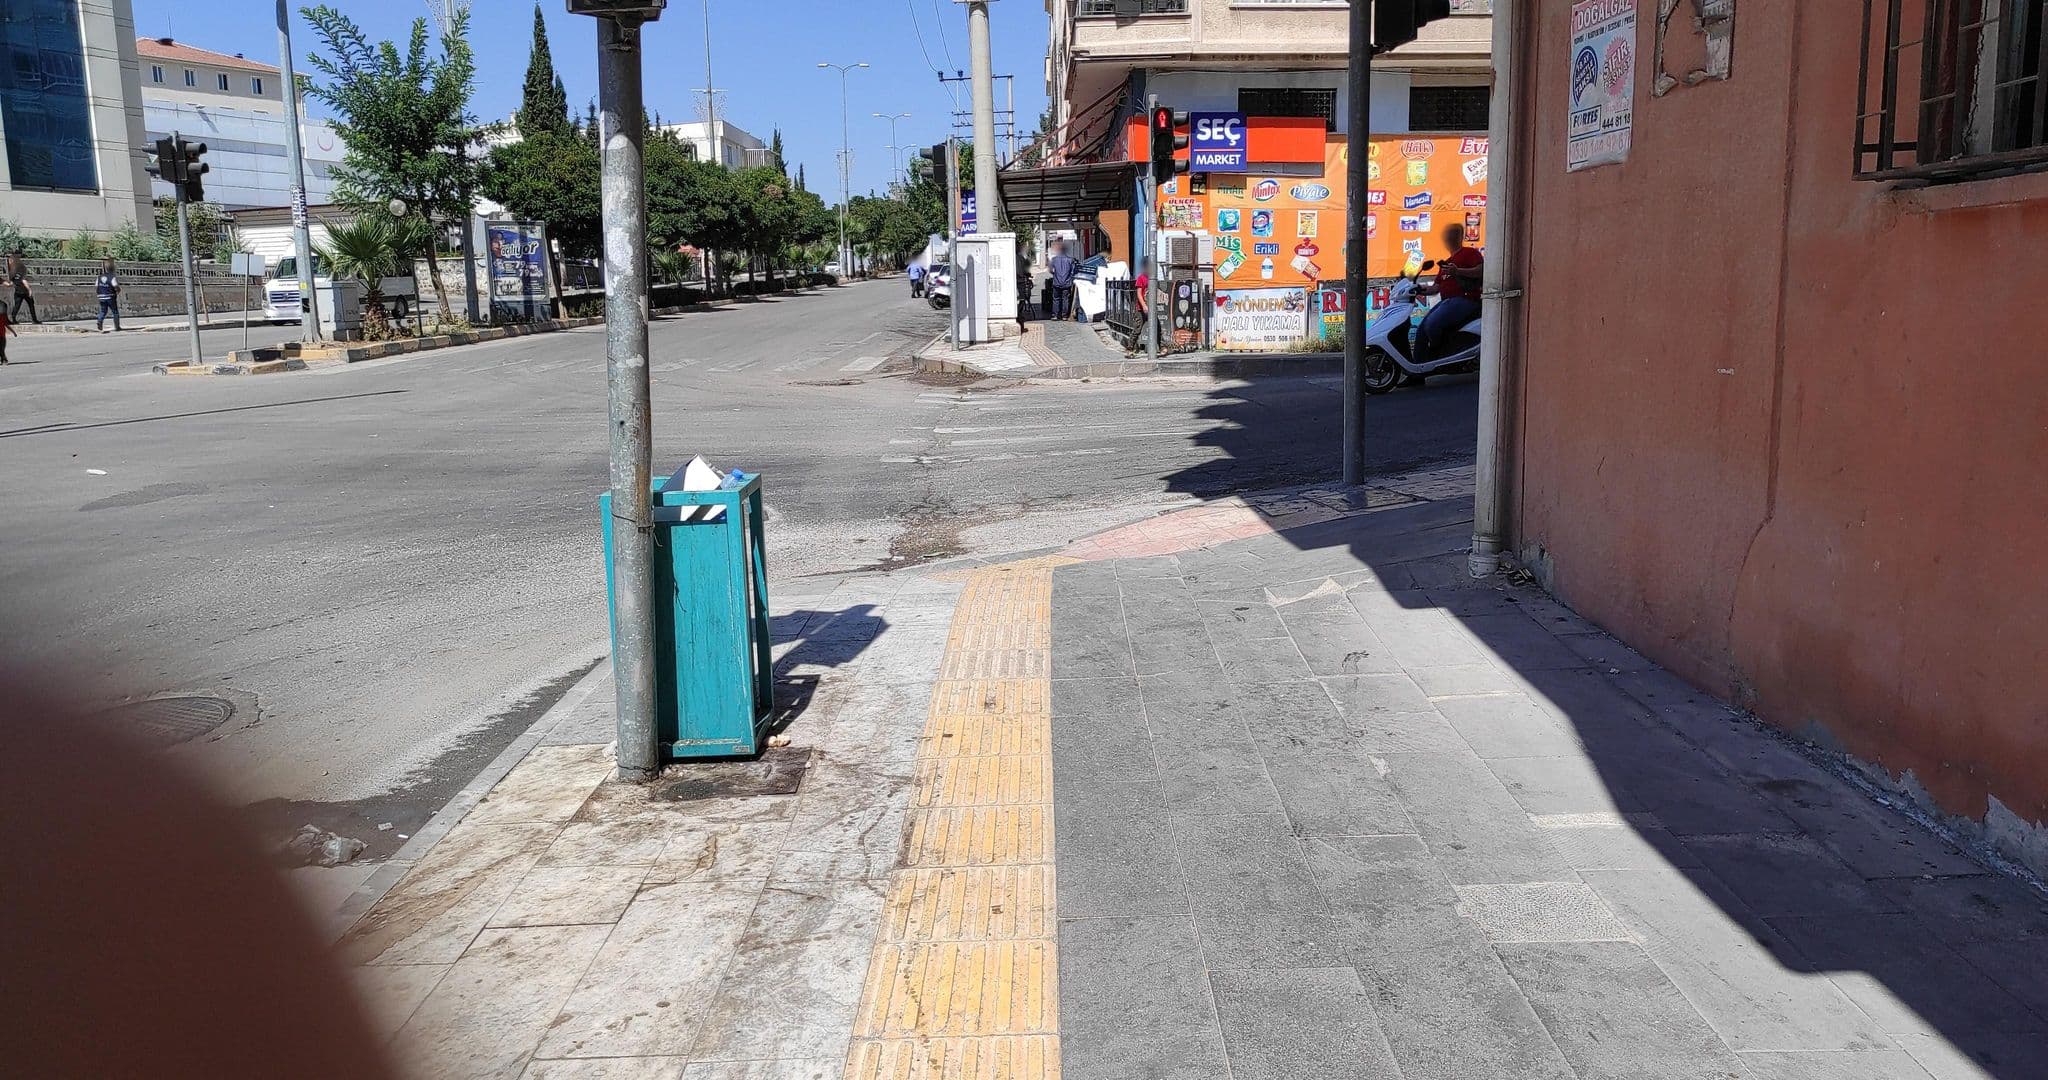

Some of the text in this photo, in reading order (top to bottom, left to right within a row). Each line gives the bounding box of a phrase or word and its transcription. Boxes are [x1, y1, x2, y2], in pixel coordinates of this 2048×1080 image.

[1603, 41, 1628, 80] SIFIR
[1573, 109, 1598, 128] FORTES
[1602, 117, 1614, 129] 444
[1196, 118, 1241, 146] SEÇ
[1195, 154, 1241, 165] MARKET
[1255, 244, 1278, 254] Erikli
[1233, 295, 1286, 312] YÖNDEM
[1222, 315, 1301, 331] HALI YIKAMA
